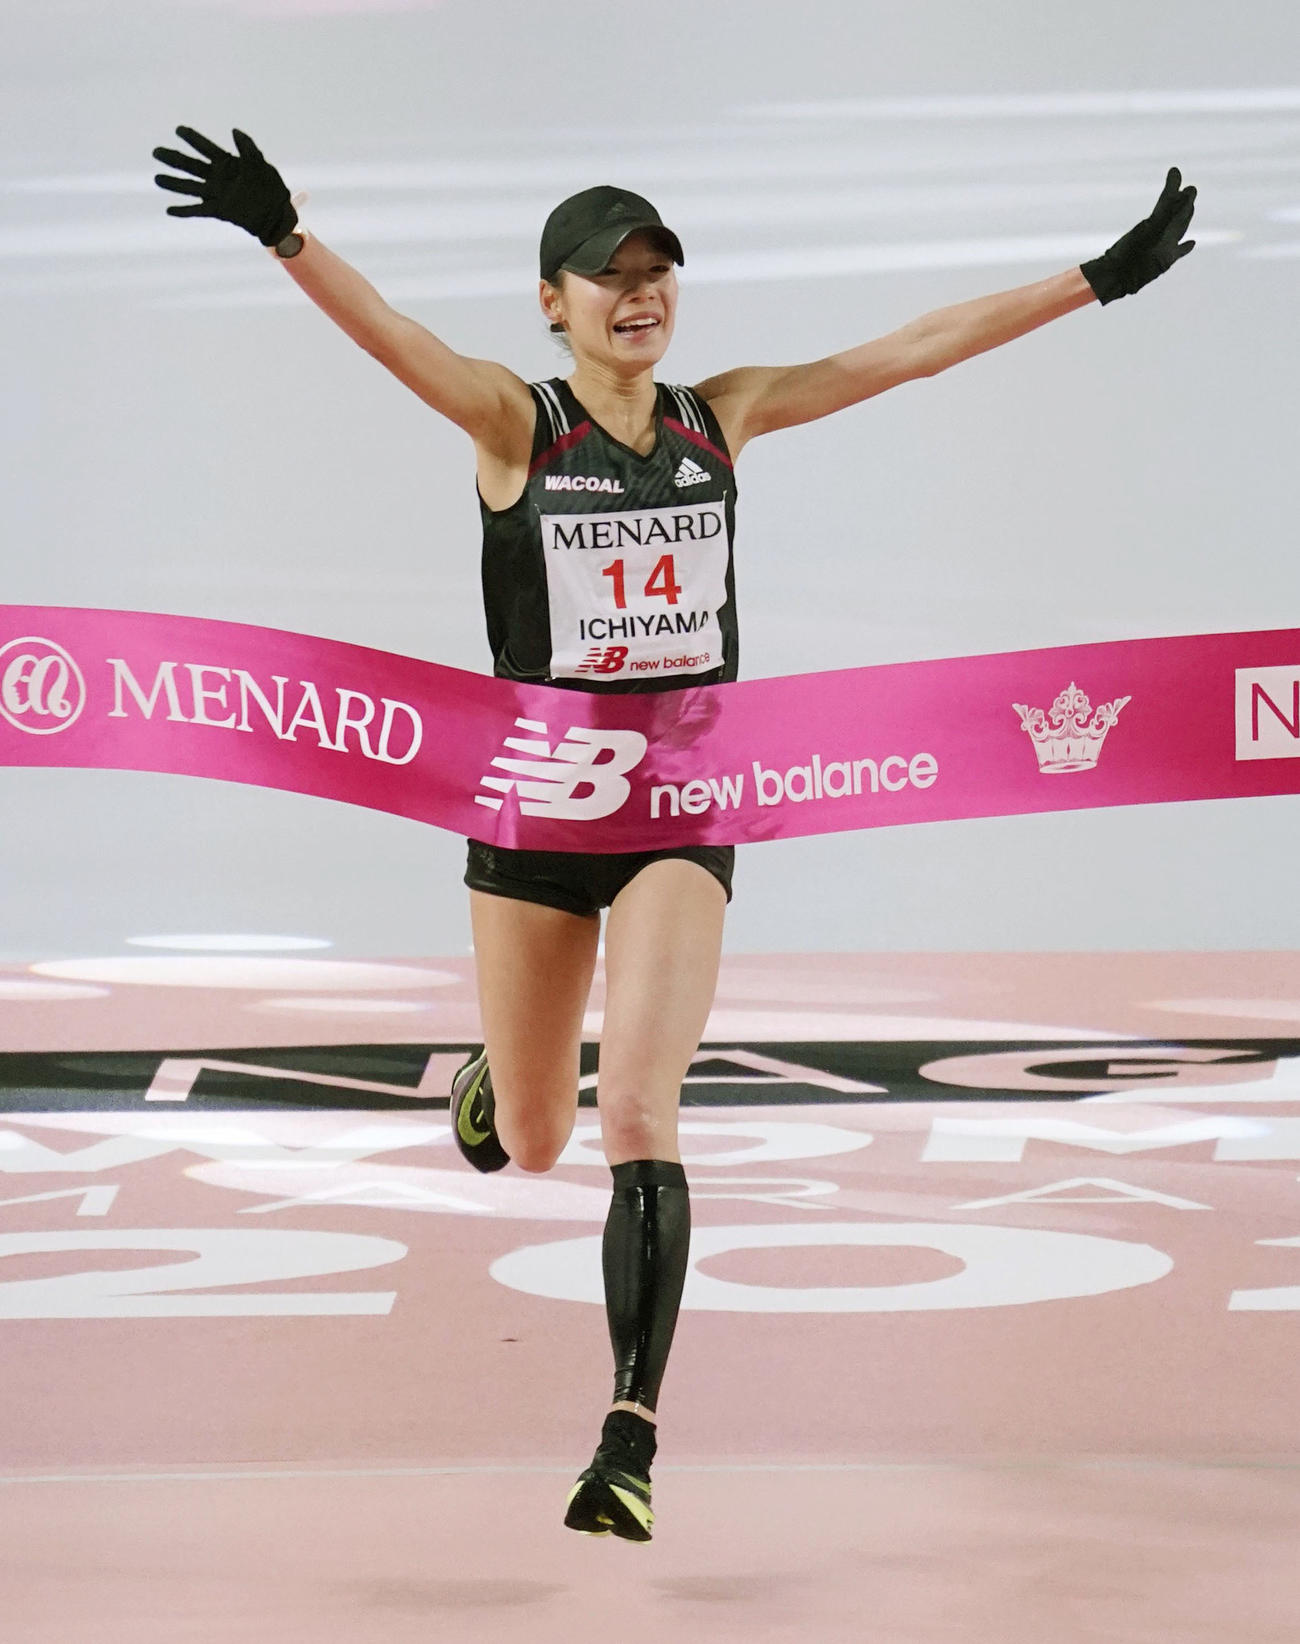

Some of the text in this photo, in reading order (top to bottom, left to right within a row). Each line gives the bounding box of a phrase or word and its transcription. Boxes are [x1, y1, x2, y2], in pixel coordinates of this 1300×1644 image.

[544, 475, 625, 494] WACOAL
[552, 511, 722, 550] MENARD
[602, 554, 682, 609] 14
[630, 659, 660, 672] new
[663, 651, 711, 669] balance
[105, 658, 423, 766] MENARD
[1251, 681, 1300, 741] N
[650, 773, 744, 819] new
[752, 752, 939, 807] balance
